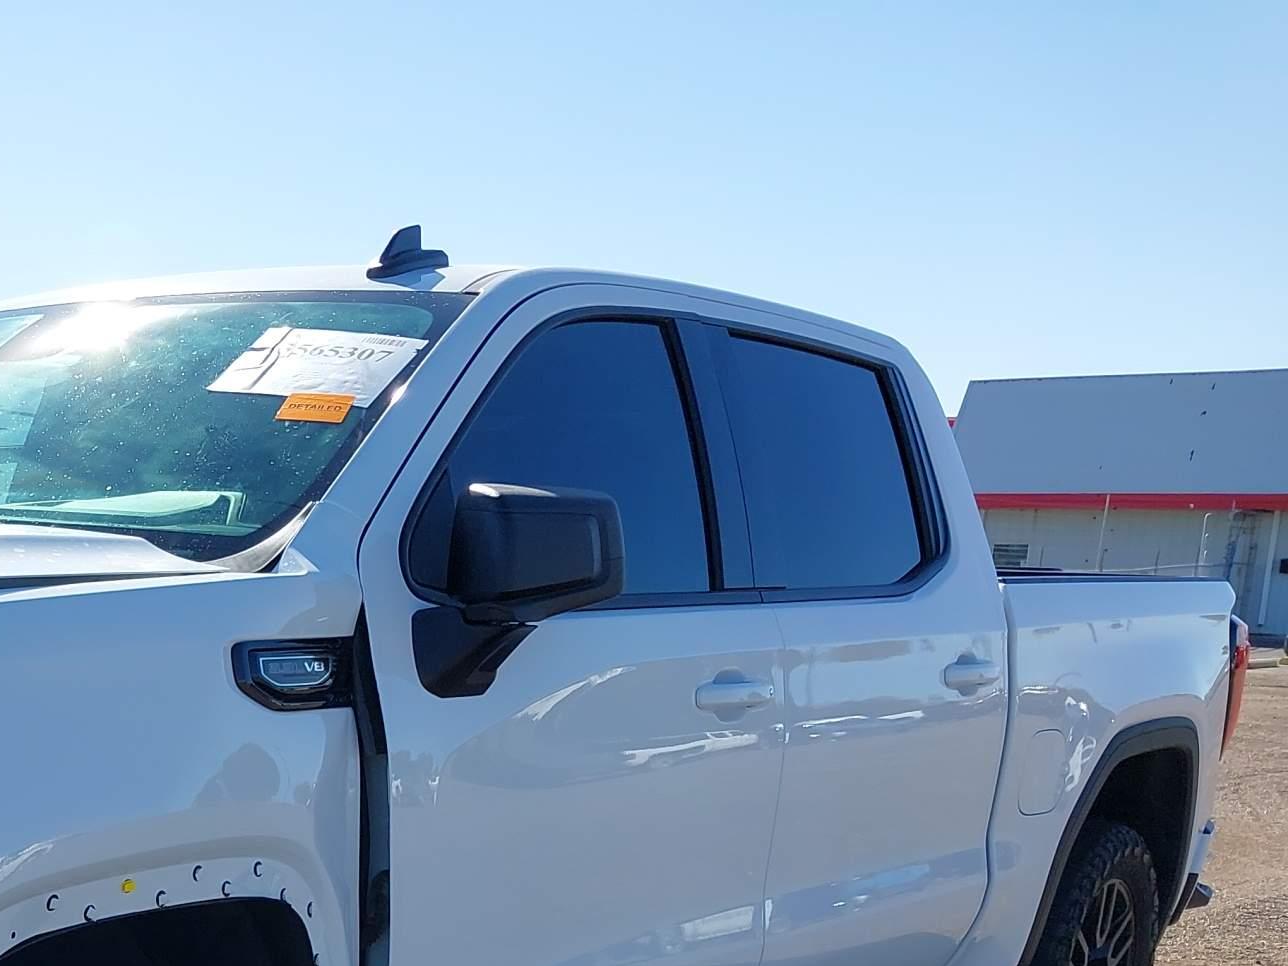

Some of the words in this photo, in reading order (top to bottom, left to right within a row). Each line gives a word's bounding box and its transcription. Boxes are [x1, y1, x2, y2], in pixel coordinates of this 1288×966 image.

[283, 342, 395, 362] 565307
[286, 403, 343, 412] DETAILED
[304, 661, 325, 672] V8
